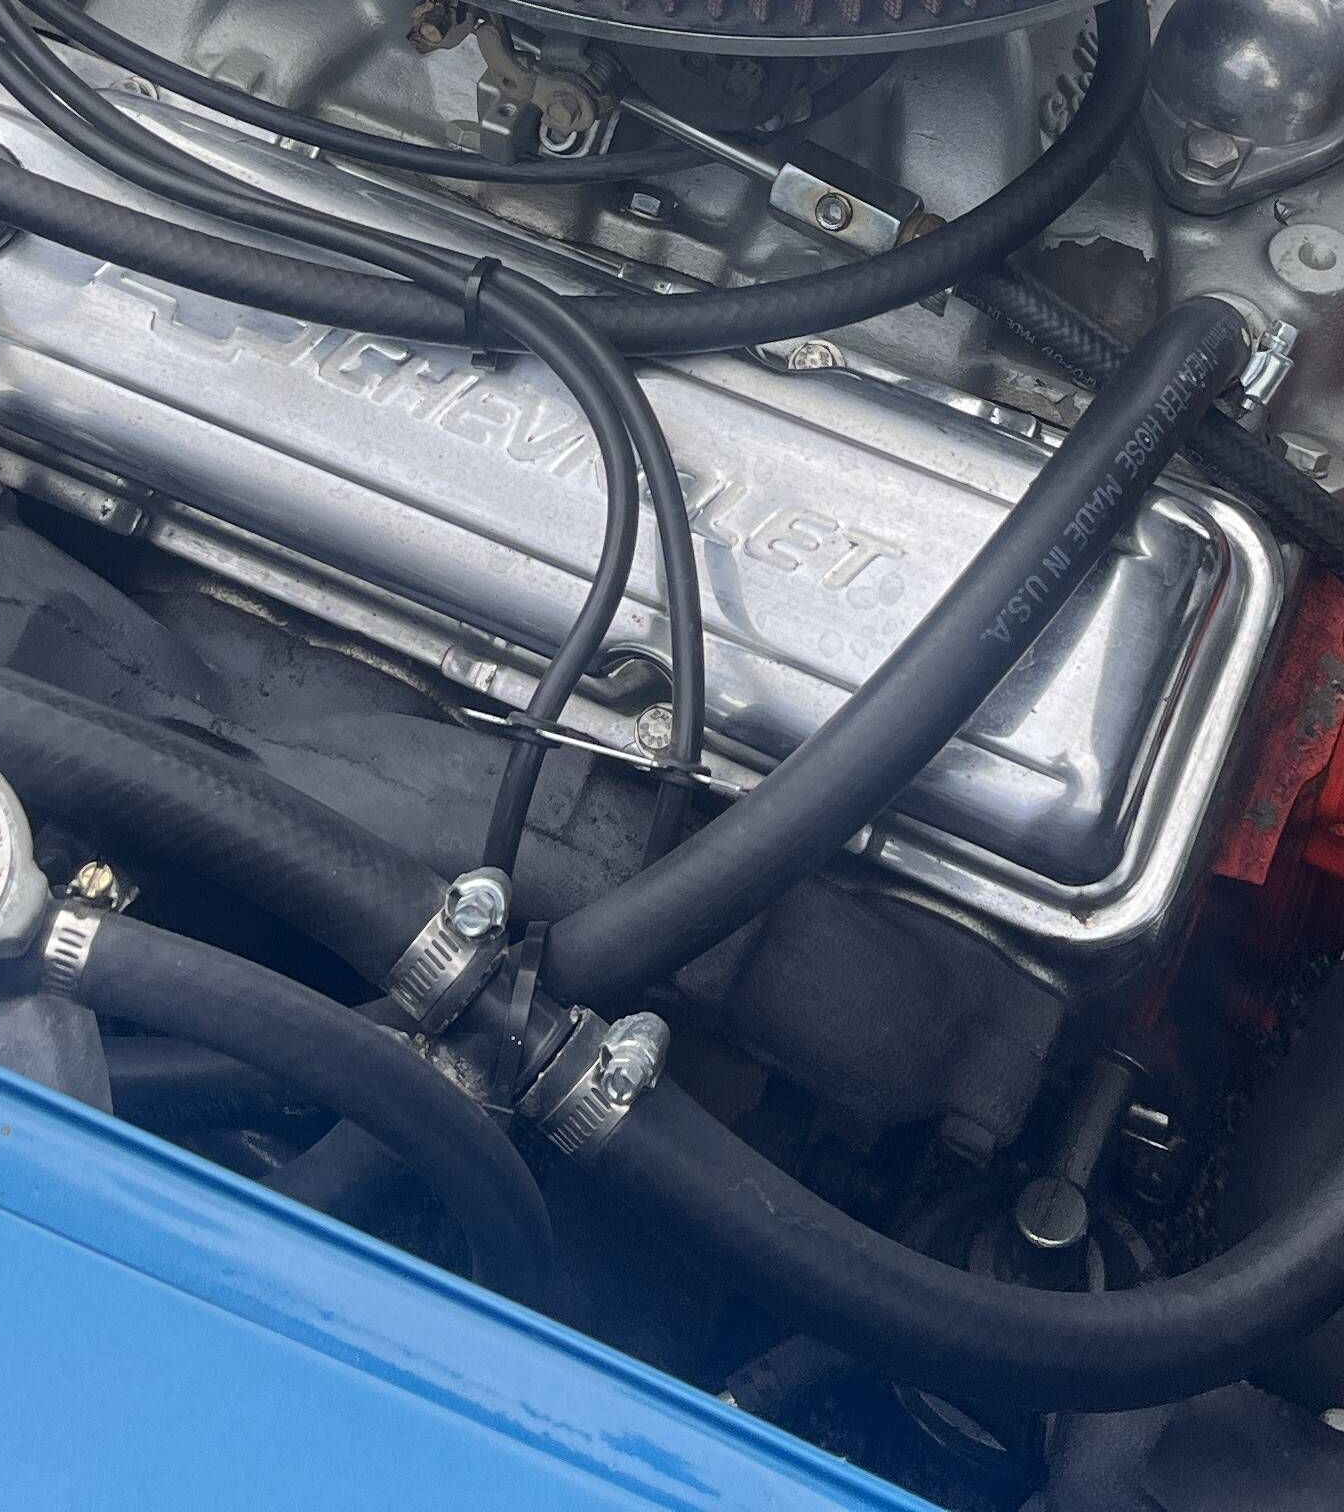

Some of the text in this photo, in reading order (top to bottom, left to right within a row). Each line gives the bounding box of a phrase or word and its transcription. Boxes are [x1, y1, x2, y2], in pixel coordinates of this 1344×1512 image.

[1115, 415, 1168, 478] HOSE
[1064, 473, 1123, 552] MADE
[1042, 545, 1071, 579] IN
